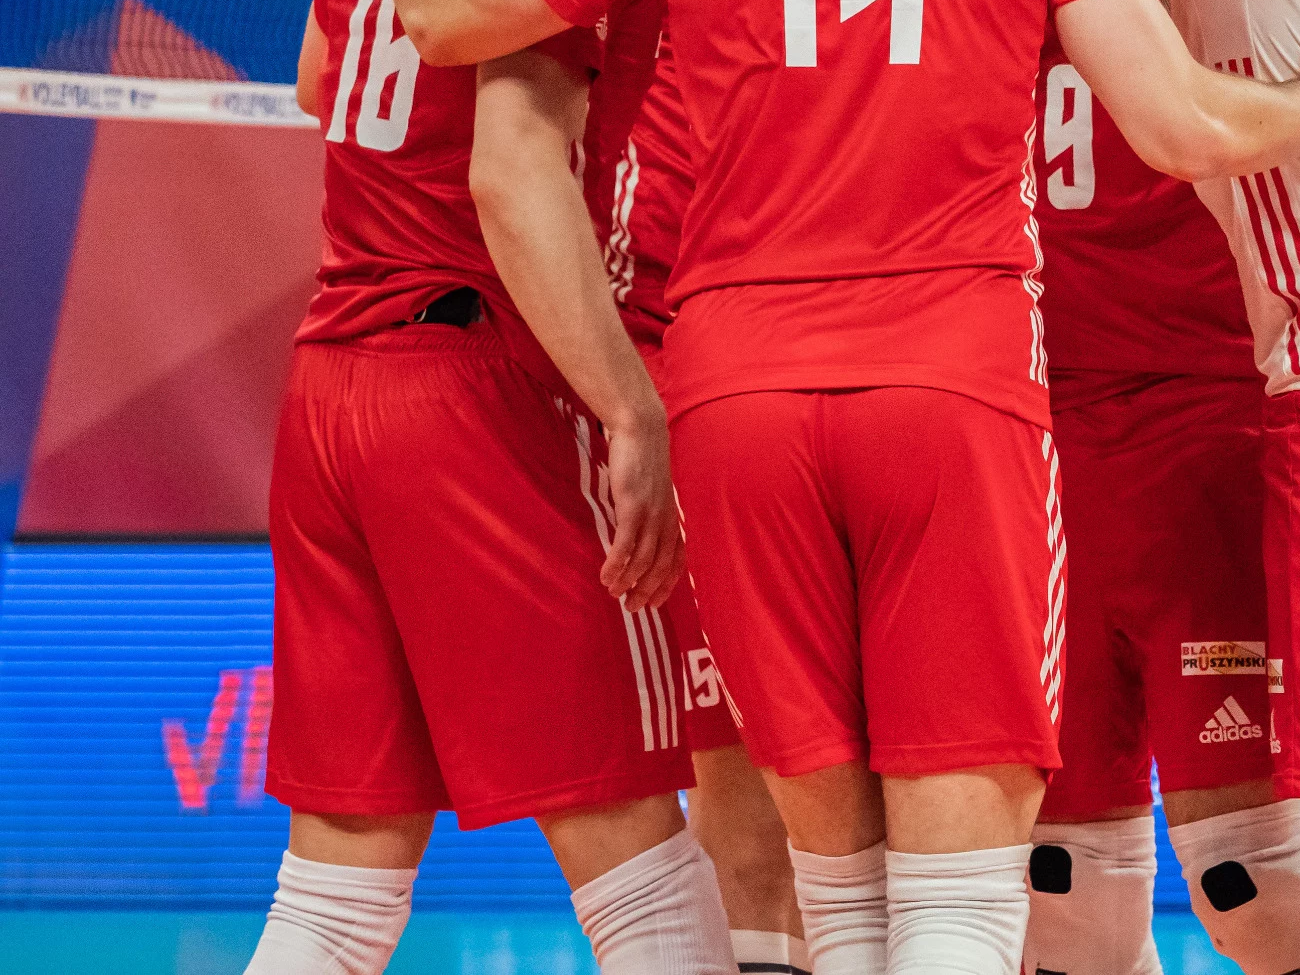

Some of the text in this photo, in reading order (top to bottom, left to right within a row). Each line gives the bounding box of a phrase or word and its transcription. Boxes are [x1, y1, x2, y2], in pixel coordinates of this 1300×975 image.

[1043, 63, 1096, 211] 9
[1182, 644, 1237, 656] BLACHY
[1199, 725, 1264, 744] adidas
